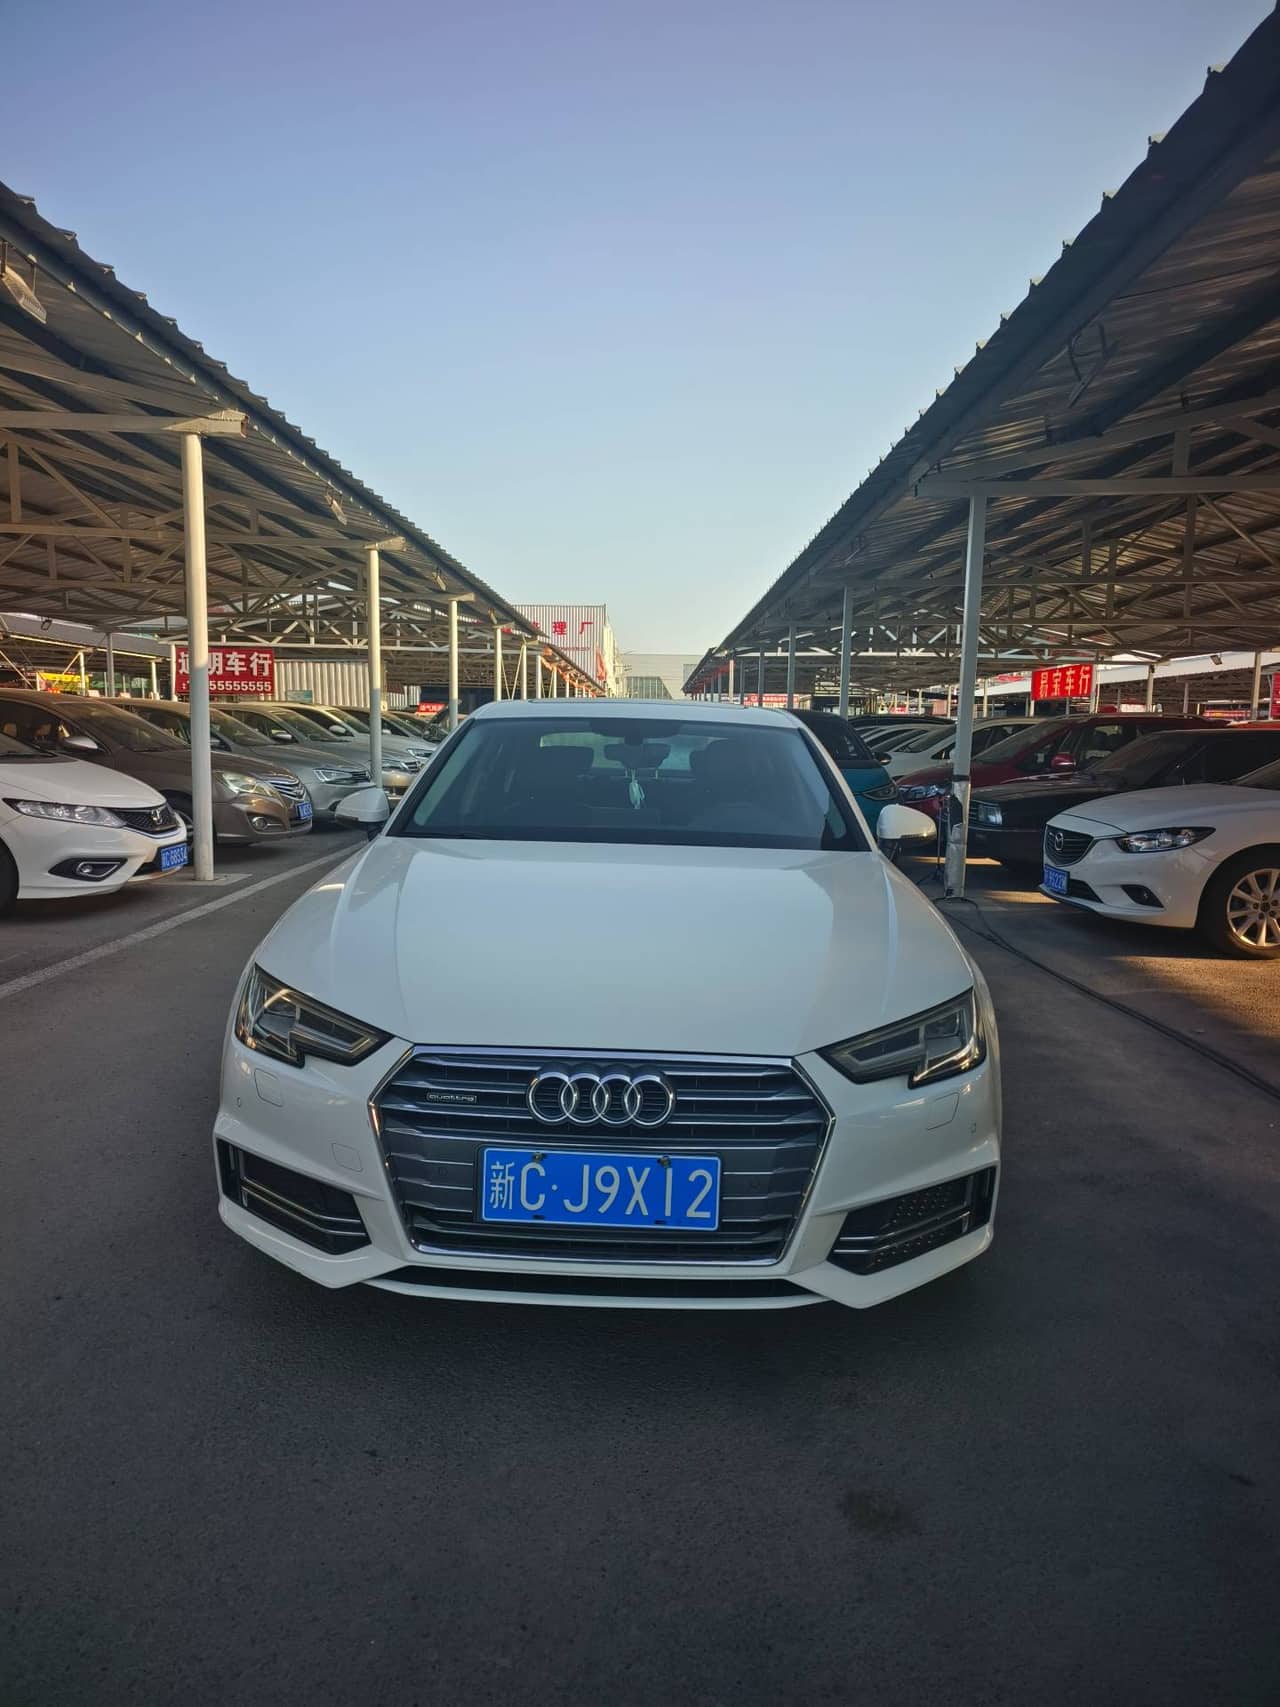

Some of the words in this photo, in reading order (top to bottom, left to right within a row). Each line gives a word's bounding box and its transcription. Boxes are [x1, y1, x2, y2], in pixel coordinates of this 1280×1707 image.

[1040, 665, 1091, 699] 易宝车行
[490, 1160, 713, 1219] 新C·J9X12
